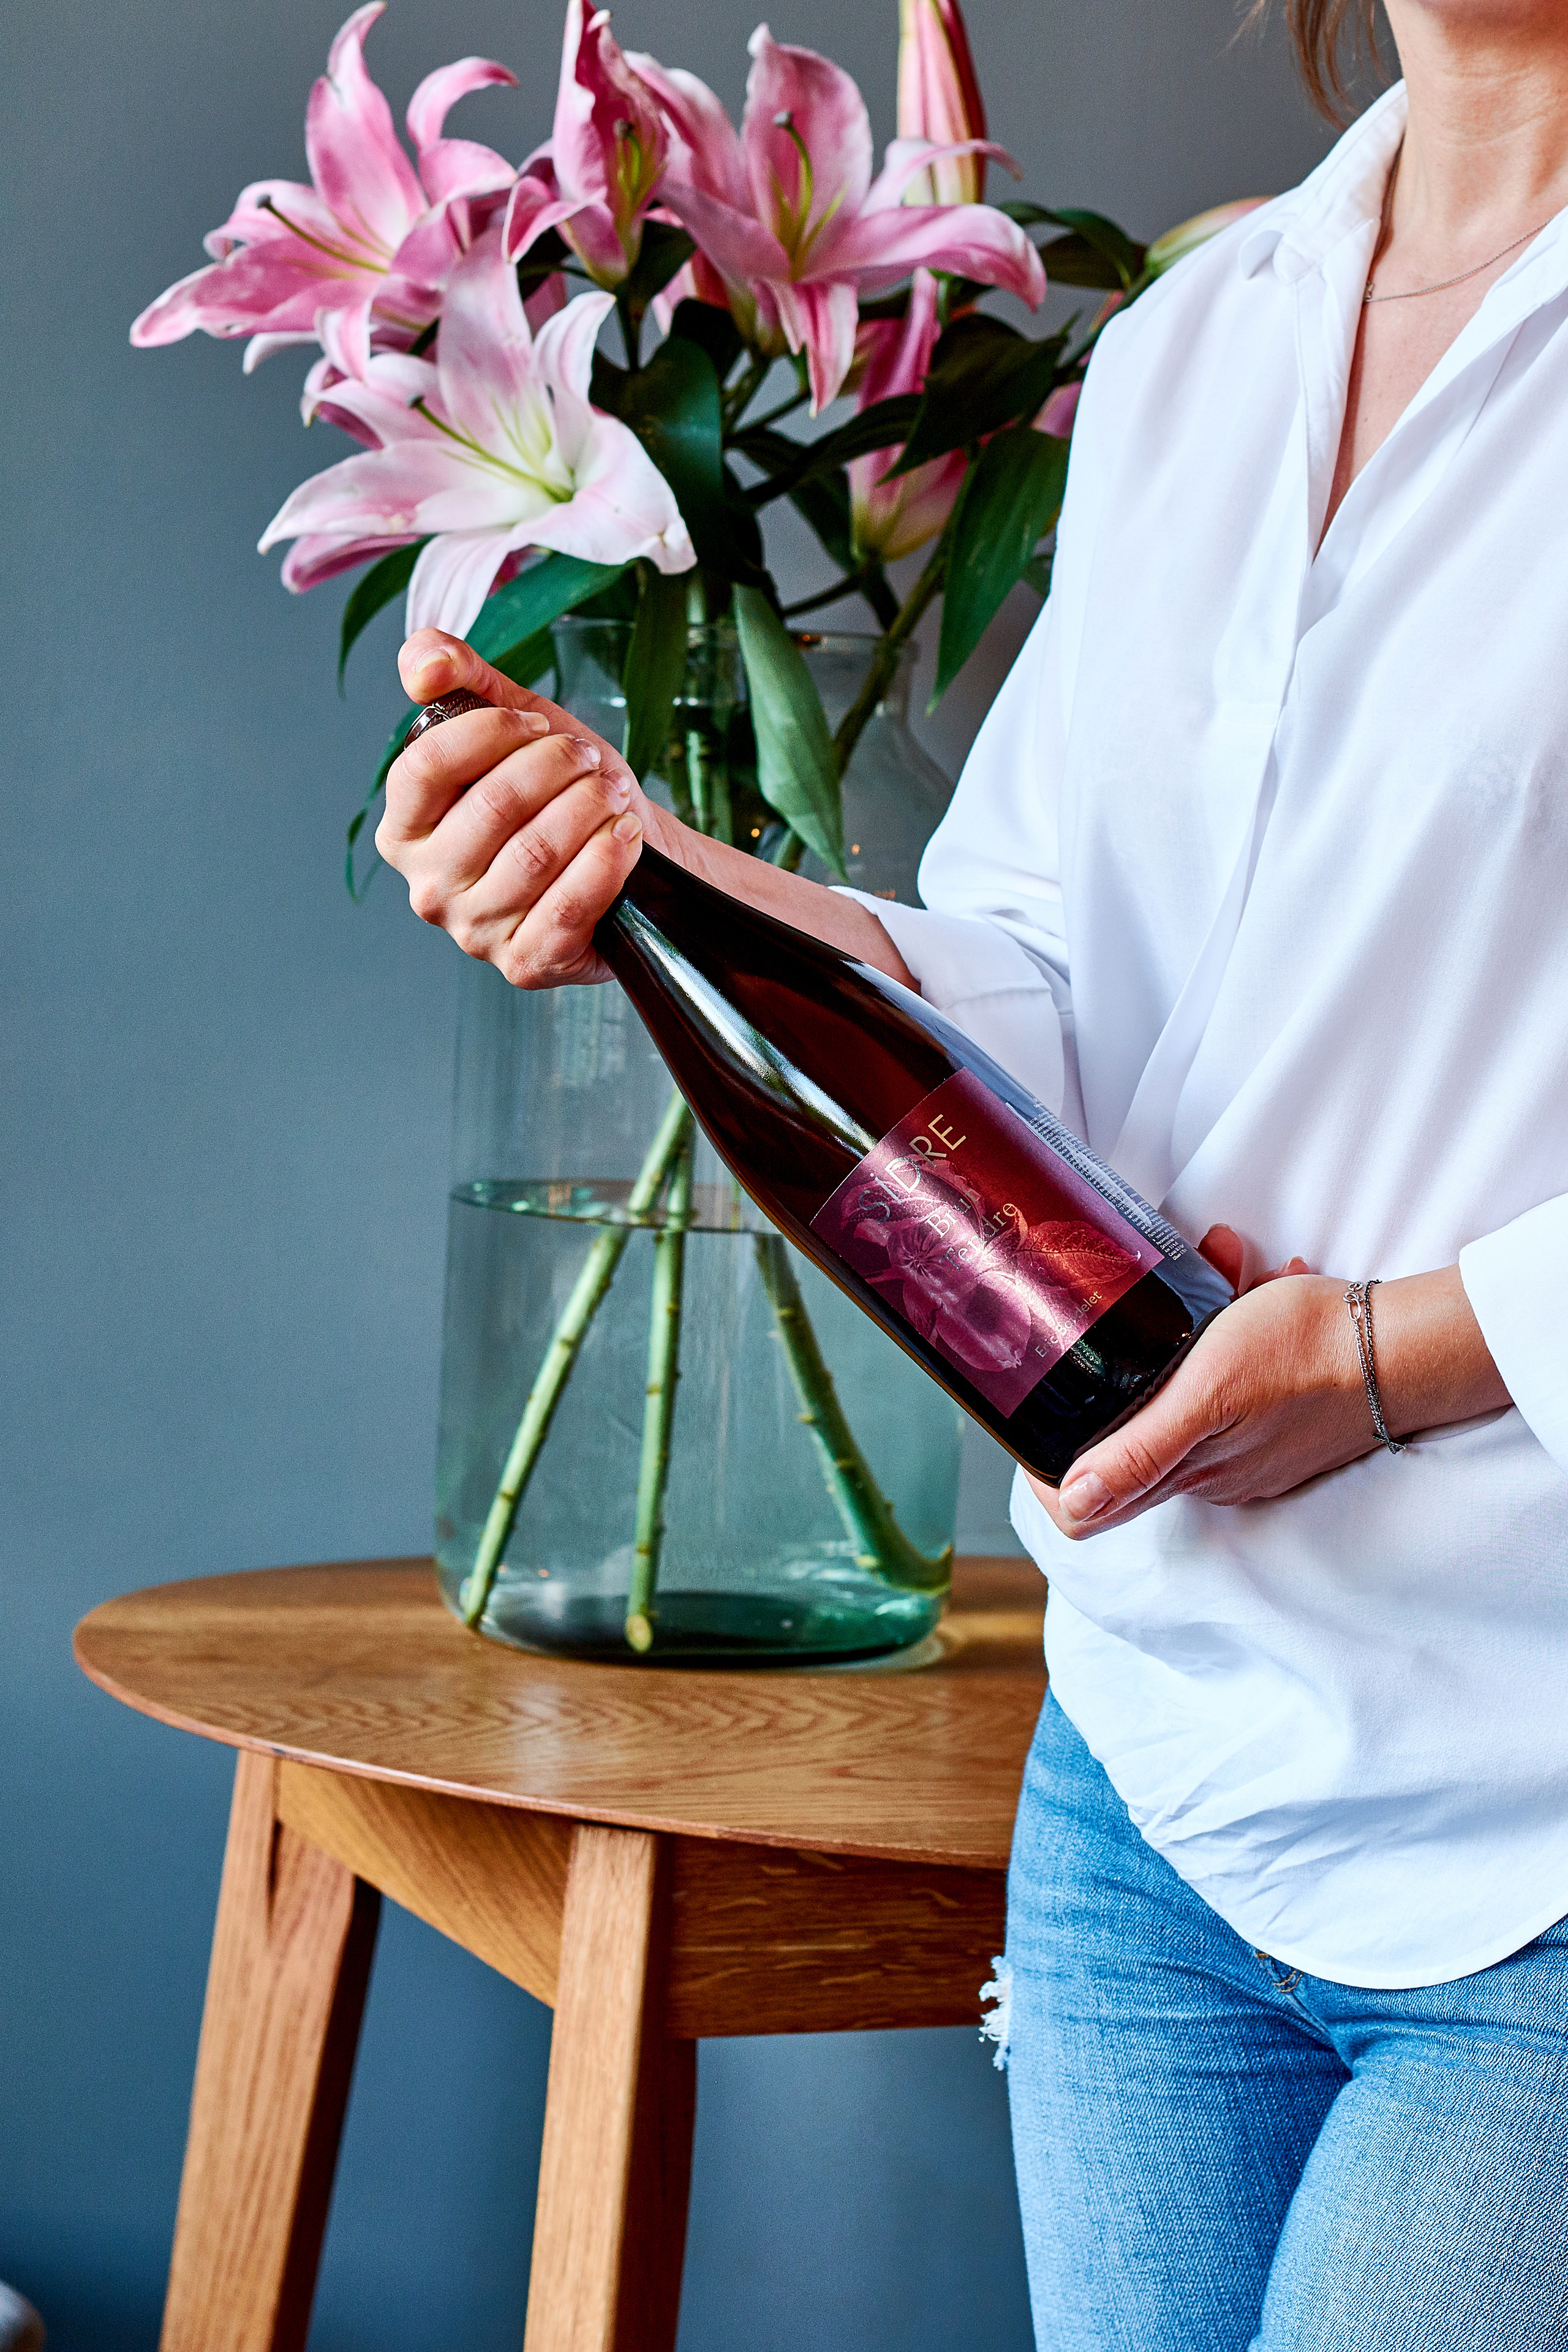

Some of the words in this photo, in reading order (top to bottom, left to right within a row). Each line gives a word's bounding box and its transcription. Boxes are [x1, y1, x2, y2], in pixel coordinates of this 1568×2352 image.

[924, 1188, 981, 1238] Brut
[938, 1203, 1017, 1272] Tendre
[1035, 1335, 1058, 1358] Eric
[1055, 1291, 1102, 1336] Bordelet
